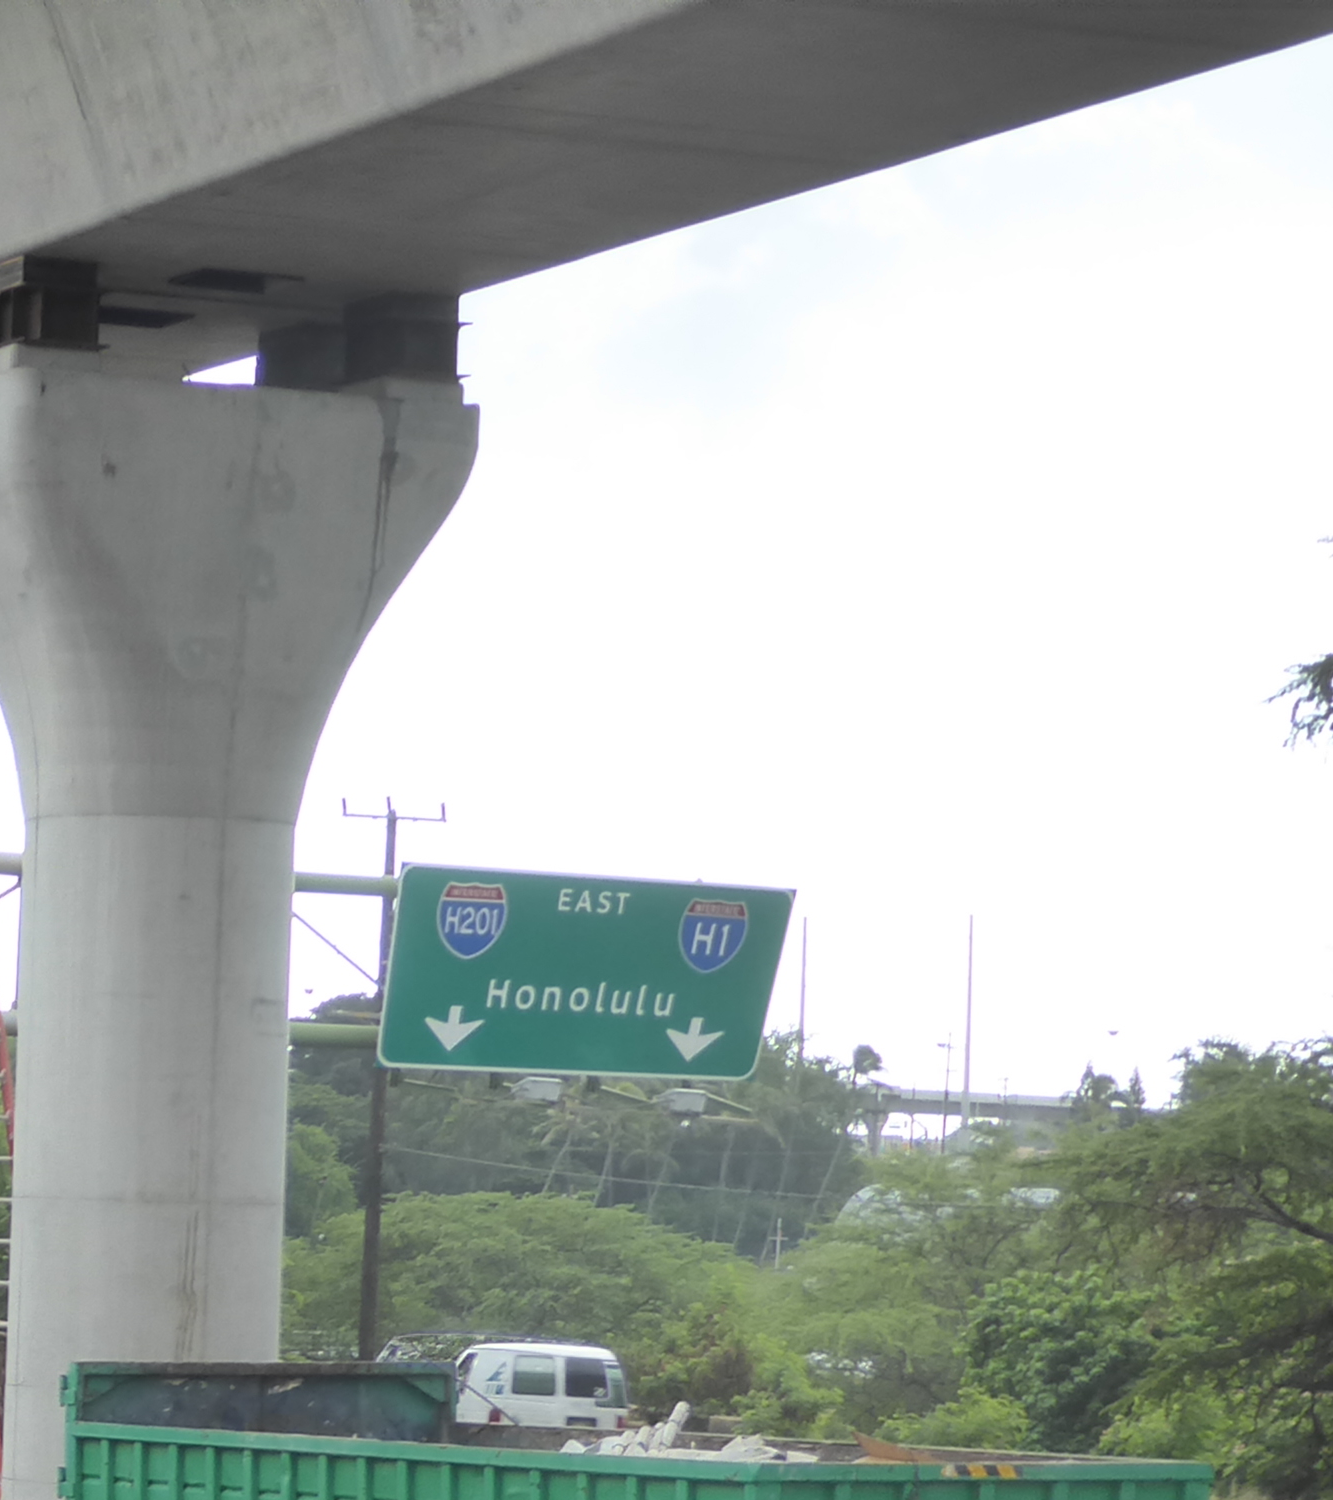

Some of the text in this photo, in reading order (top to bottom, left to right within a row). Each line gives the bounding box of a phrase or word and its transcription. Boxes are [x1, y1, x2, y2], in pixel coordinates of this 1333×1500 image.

[557, 888, 631, 915] EAST
[444, 906, 499, 935] H201
[691, 921, 730, 957] H1
[485, 978, 676, 1017] Honolulu
